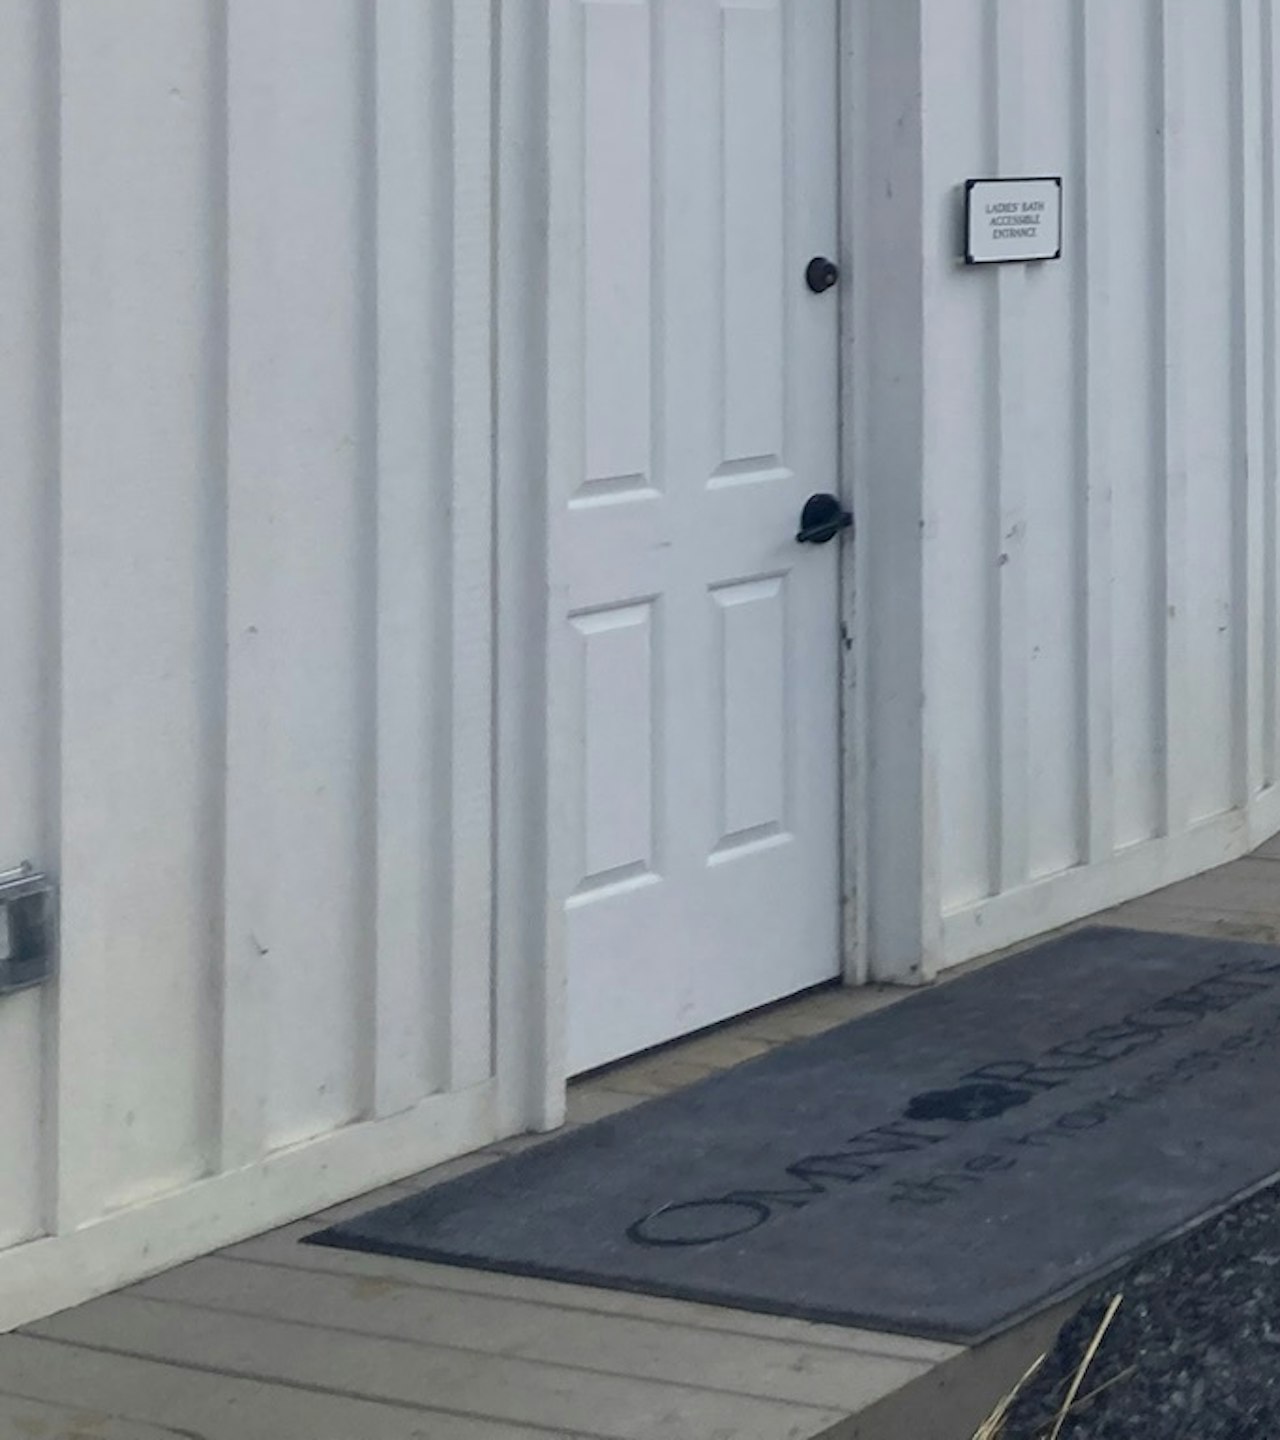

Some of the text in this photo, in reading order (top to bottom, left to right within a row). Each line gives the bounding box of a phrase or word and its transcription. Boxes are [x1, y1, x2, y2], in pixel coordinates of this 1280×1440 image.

[985, 201, 1044, 213] LADIES' BATH
[990, 214, 1041, 225] ACCESSIBLE
[993, 227, 1036, 239] ENTRANCE
[625, 1120, 951, 1247] OMNI
[889, 1154, 1018, 1205] the
